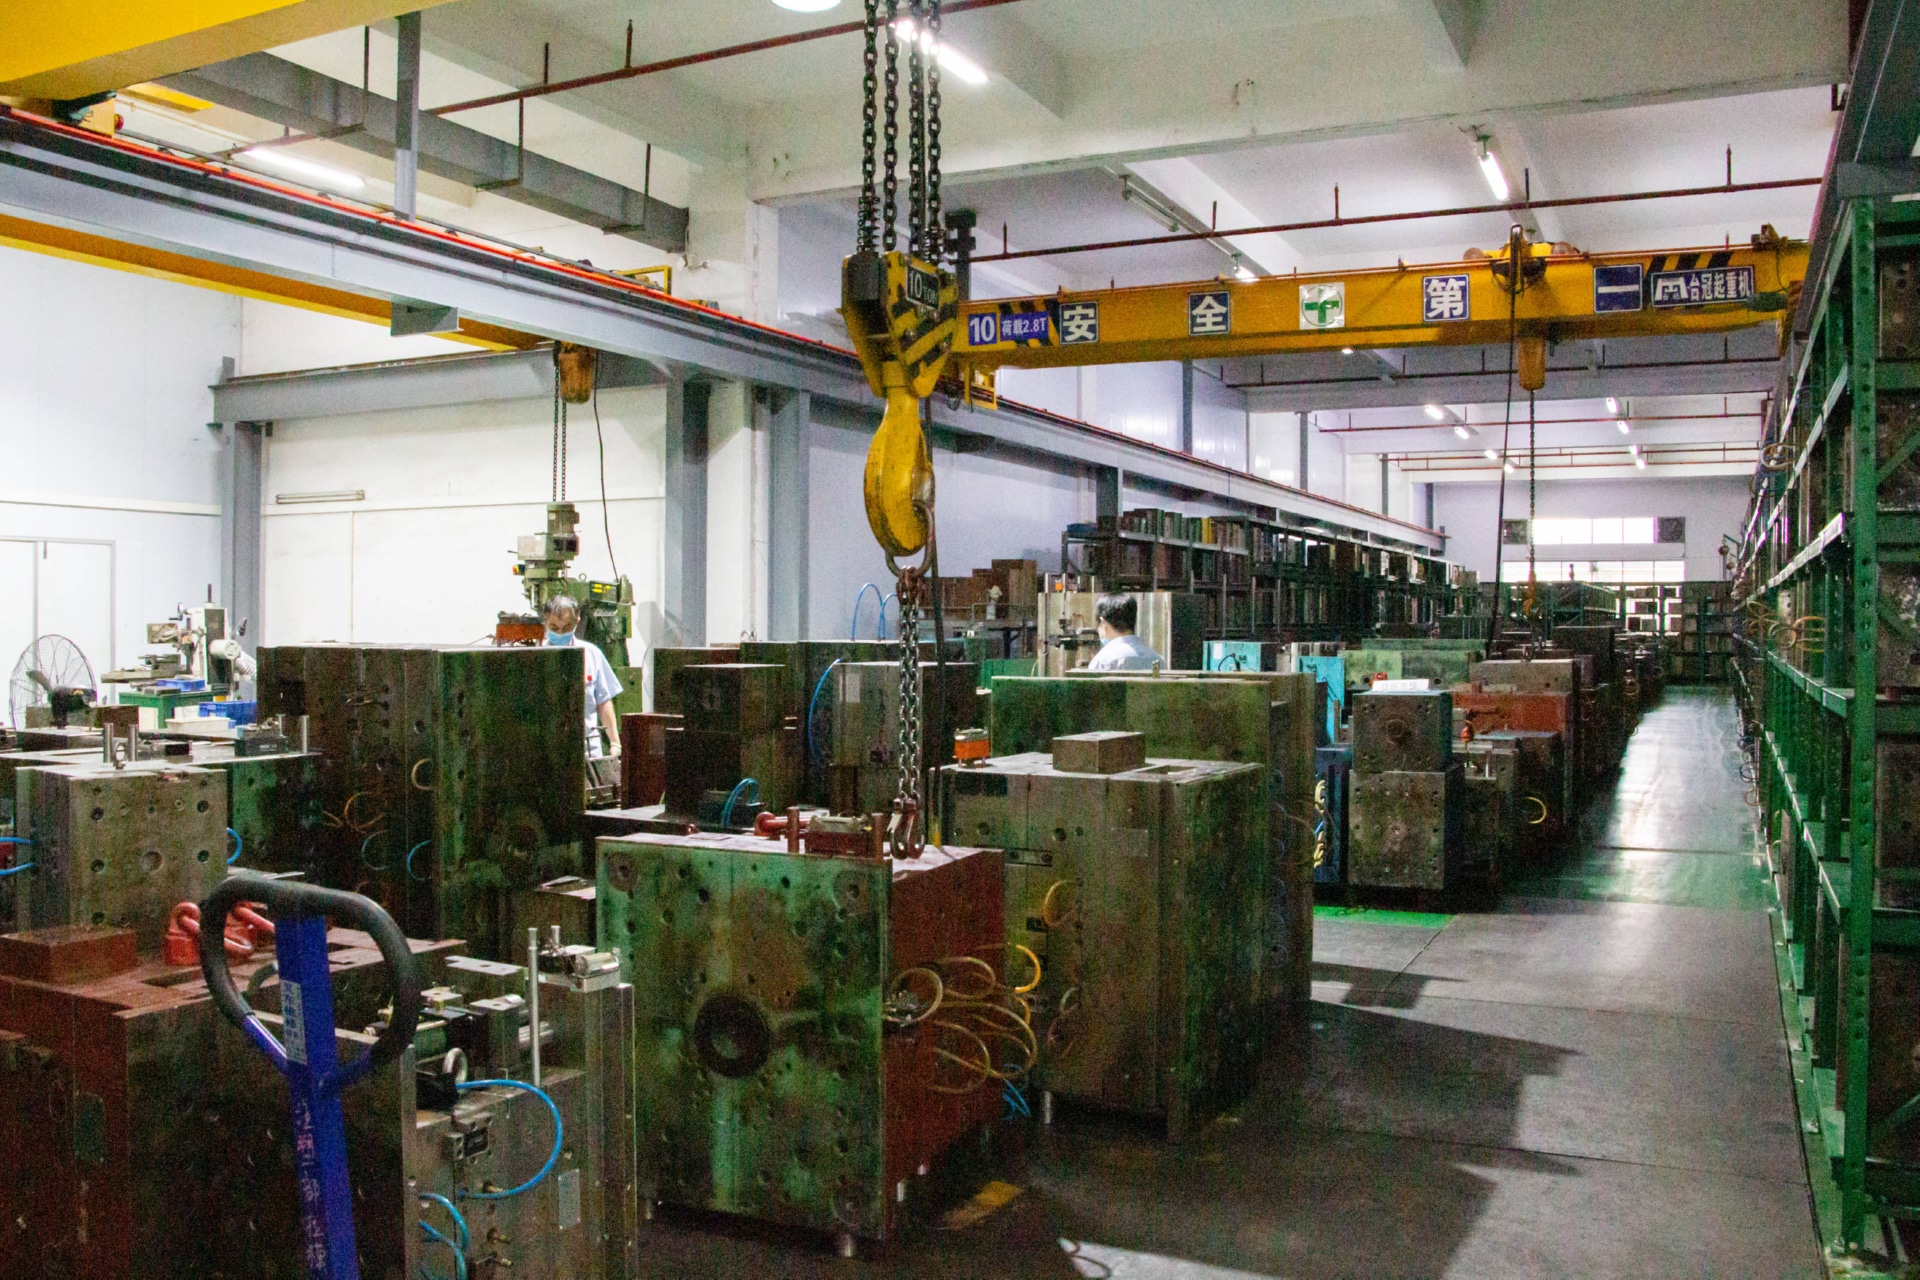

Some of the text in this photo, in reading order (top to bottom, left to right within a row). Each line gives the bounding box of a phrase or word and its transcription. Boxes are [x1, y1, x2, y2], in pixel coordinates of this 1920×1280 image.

[910, 270, 922, 299] 10
[1690, 271, 1750, 301] 台冠起重机
[1063, 304, 1096, 340] 安
[1191, 295, 1227, 332] 全
[1426, 278, 1465, 318] 第
[970, 316, 995, 343] 10
